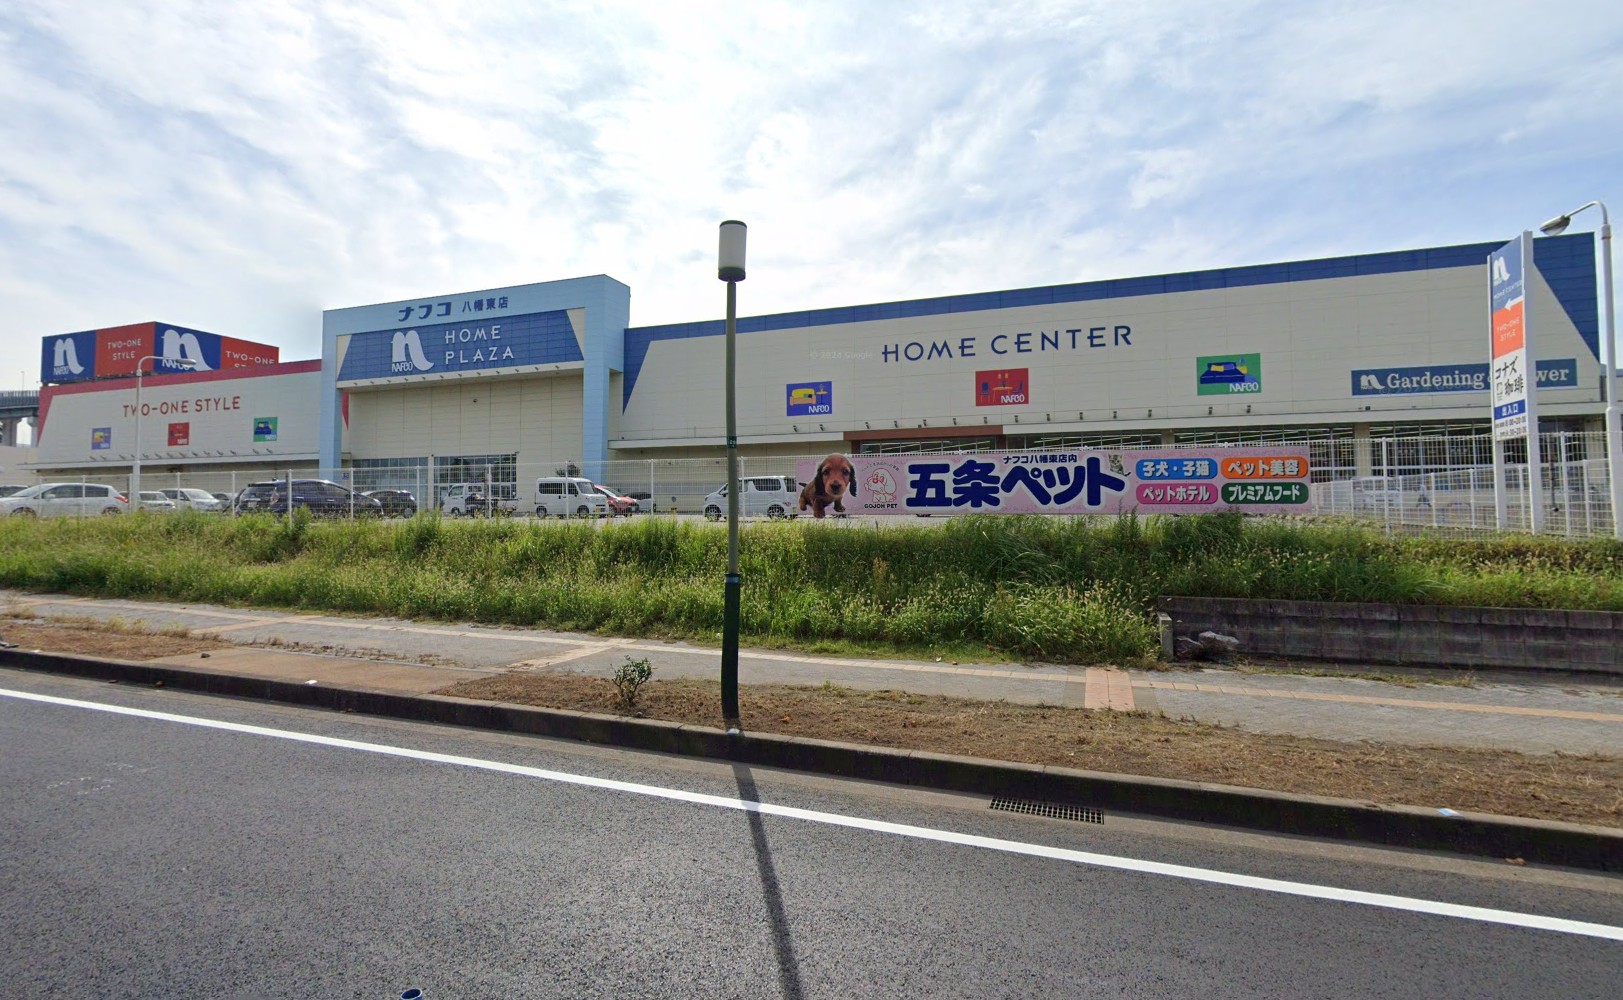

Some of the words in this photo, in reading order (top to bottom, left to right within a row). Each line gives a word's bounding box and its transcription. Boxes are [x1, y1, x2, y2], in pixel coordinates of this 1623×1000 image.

[398, 302, 452, 322] ナフコ
[462, 296, 508, 312] 八幡東店
[444, 325, 501, 344] HOME
[107, 338, 142, 350] TWO-ONE
[882, 337, 976, 363] HOME
[991, 325, 1132, 354] CENTER
[112, 351, 135, 361] STYLE
[226, 351, 275, 365] TWO-ONE
[445, 346, 514, 365] PLAZA
[391, 361, 413, 372] NAFCO
[1495, 356, 1518, 380] コナズ
[1229, 382, 1259, 392] NAFCO
[1386, 371, 1485, 390] Gardening
[123, 400, 188, 417] TWO-ONE
[195, 396, 240, 412] STYLE
[1001, 395, 1025, 403] NAFCO
[808, 404, 830, 413] NAFCO
[1003, 454, 1077, 464] ナフコ八幡東店内
[1142, 460, 1210, 477] 子犬・子猫
[1228, 459, 1299, 477] ペット美容
[906, 457, 1125, 508] 五条ペット
[1143, 486, 1210, 501] ペットホテル
[1229, 484, 1300, 501] プレミアムフード
